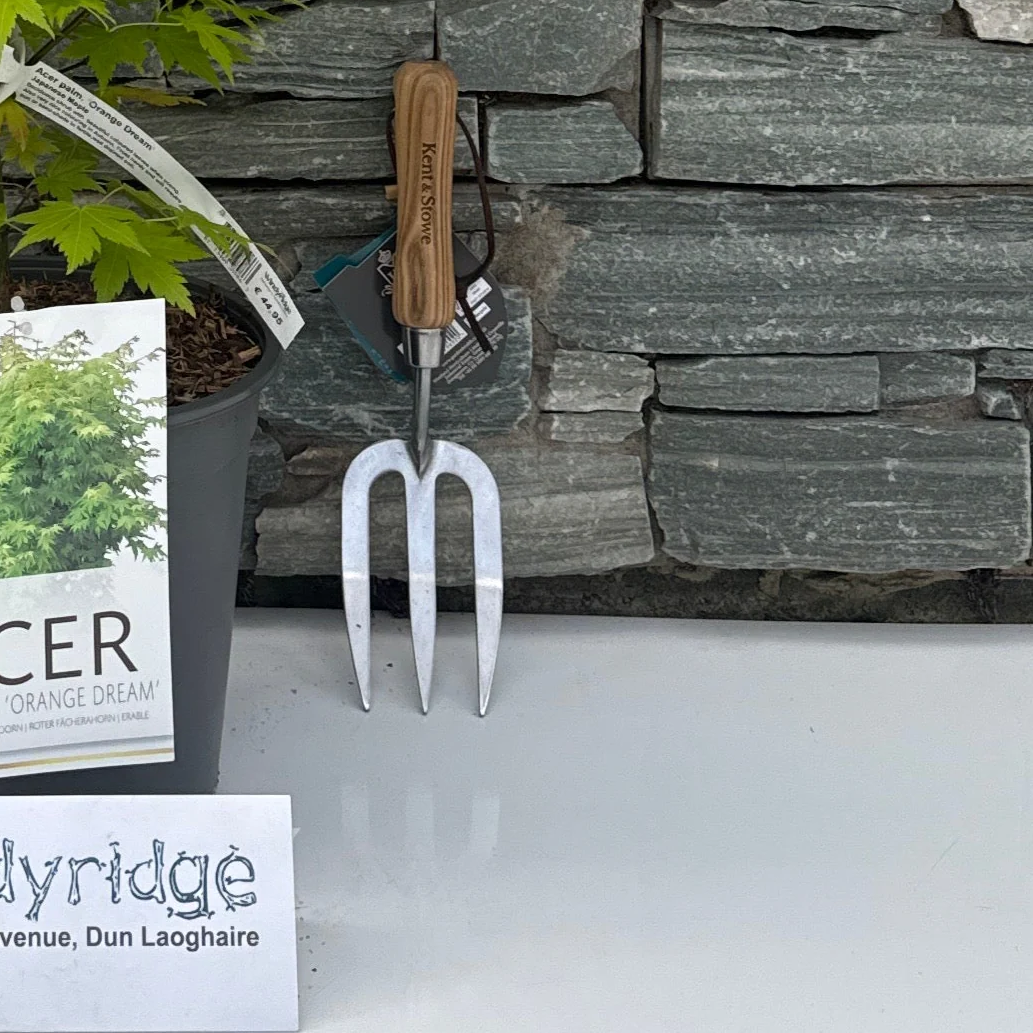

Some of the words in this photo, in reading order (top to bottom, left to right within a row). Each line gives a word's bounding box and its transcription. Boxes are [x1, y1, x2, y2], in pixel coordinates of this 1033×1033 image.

[35, 67, 59, 83] Acer
[421, 142, 436, 181] Kent
[421, 182, 432, 193] &
[420, 195, 436, 246] Stowe
[260, 297, 284, 326] 44.95
[85, 926, 133, 948] Dun
[141, 925, 260, 952] Laoghaire
